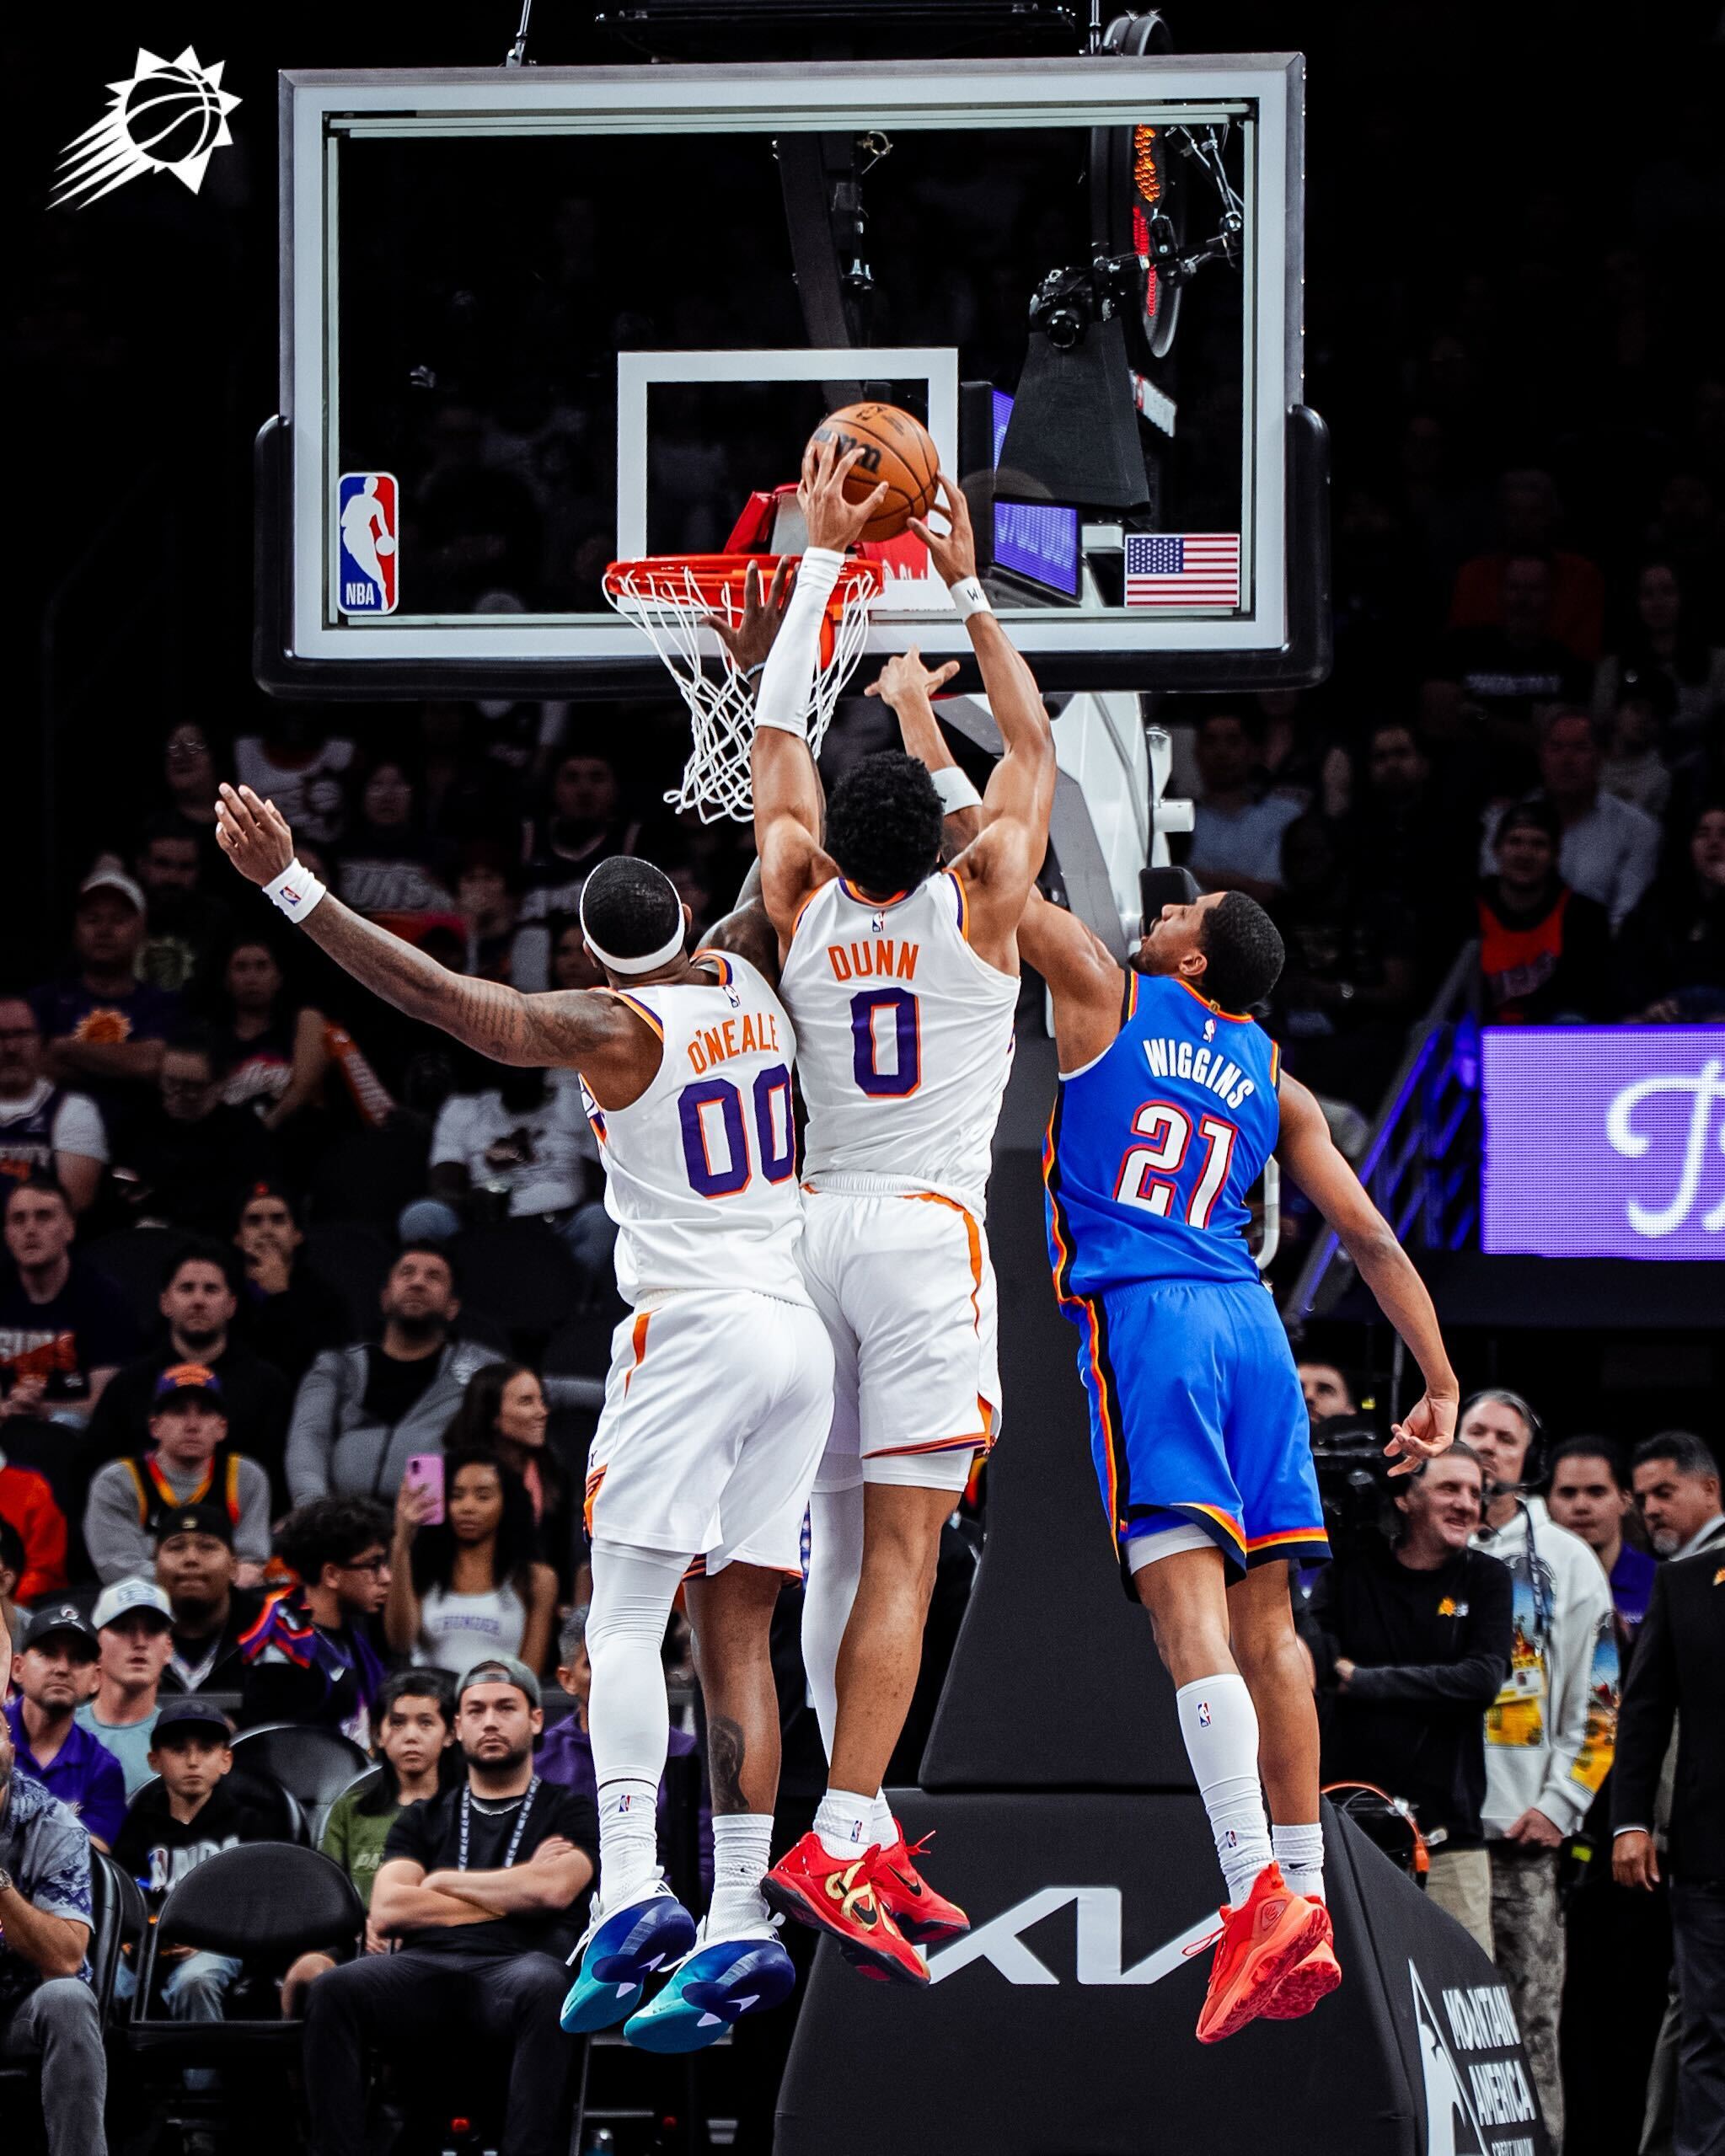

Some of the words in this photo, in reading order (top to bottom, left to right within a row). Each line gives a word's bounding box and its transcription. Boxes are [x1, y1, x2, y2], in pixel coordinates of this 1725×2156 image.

[346, 582, 375, 606] NBA
[828, 939, 919, 982] DUNN
[687, 1012, 779, 1075] O'NEALE
[849, 987, 922, 1099] 0
[1143, 1039, 1256, 1110] WIGGINS
[678, 1062, 796, 1200] 00
[1112, 1099, 1239, 1230] 21
[1442, 1986, 1522, 2052] MOUNTAIN
[1468, 2060, 1537, 2127] AMERICA
